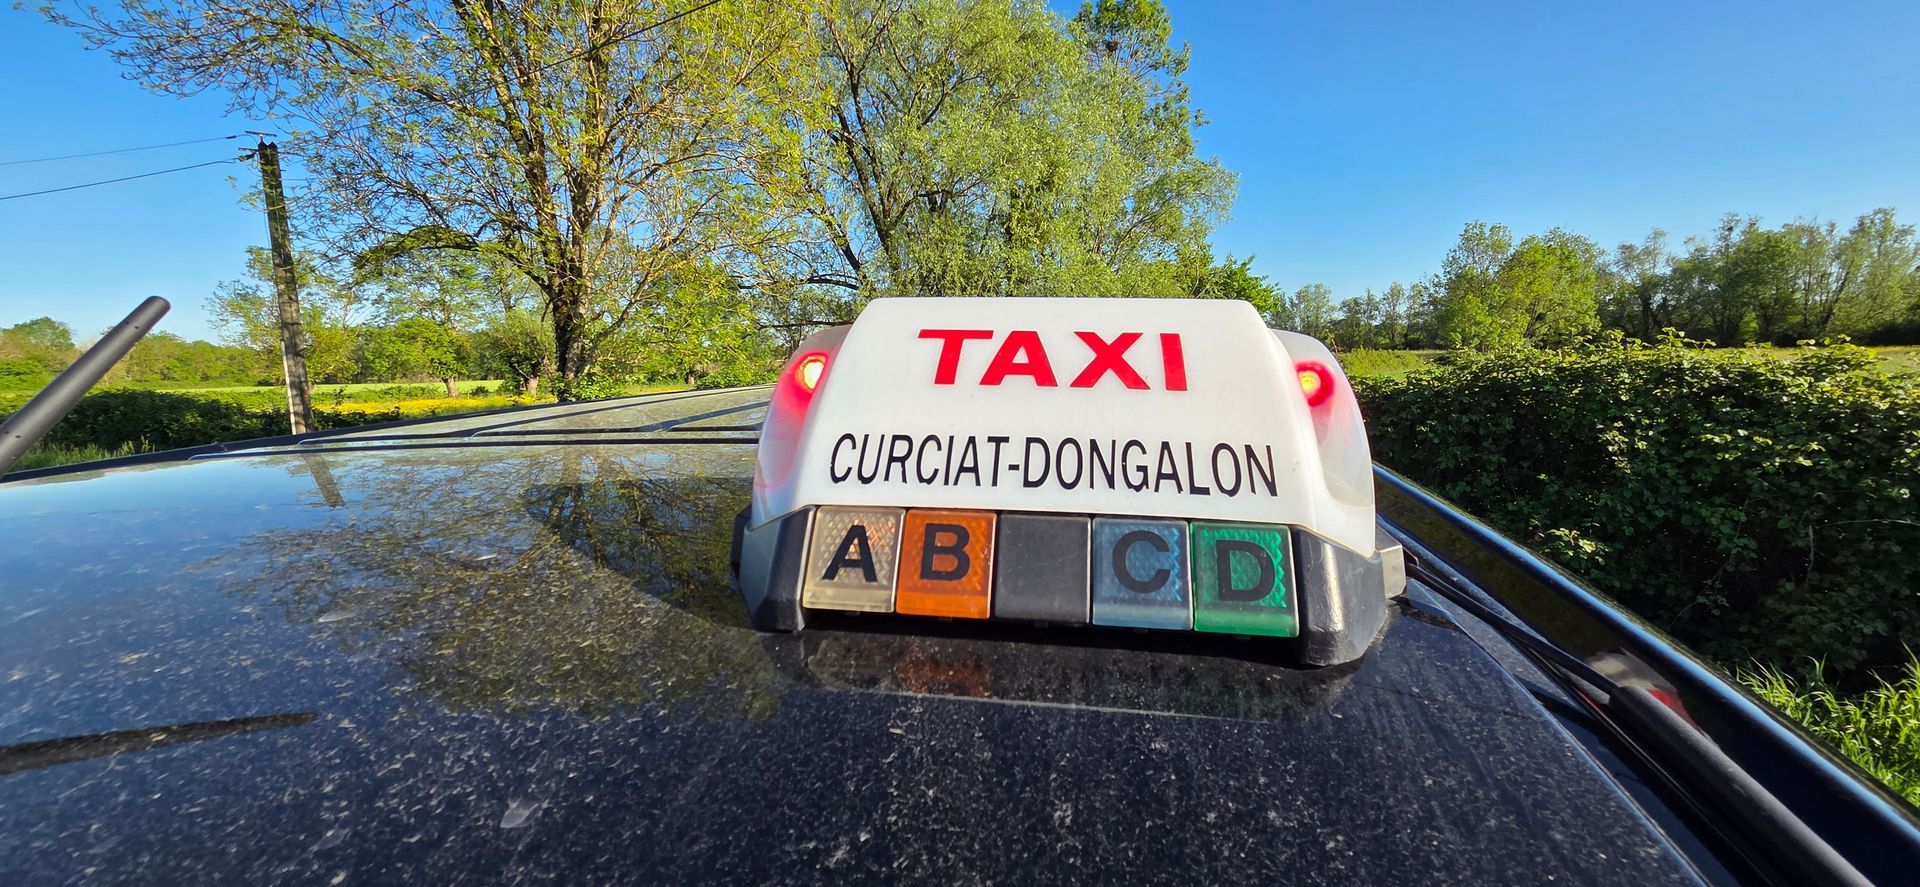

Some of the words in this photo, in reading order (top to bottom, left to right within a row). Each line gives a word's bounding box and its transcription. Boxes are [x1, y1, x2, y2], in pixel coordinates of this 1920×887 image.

[917, 329, 1188, 391] TAXI
[830, 433, 1278, 497] CURCIAT-DONGALON
[821, 525, 878, 582] A
[920, 522, 971, 581] B
[1112, 530, 1172, 593] C
[1215, 539, 1276, 602] D
